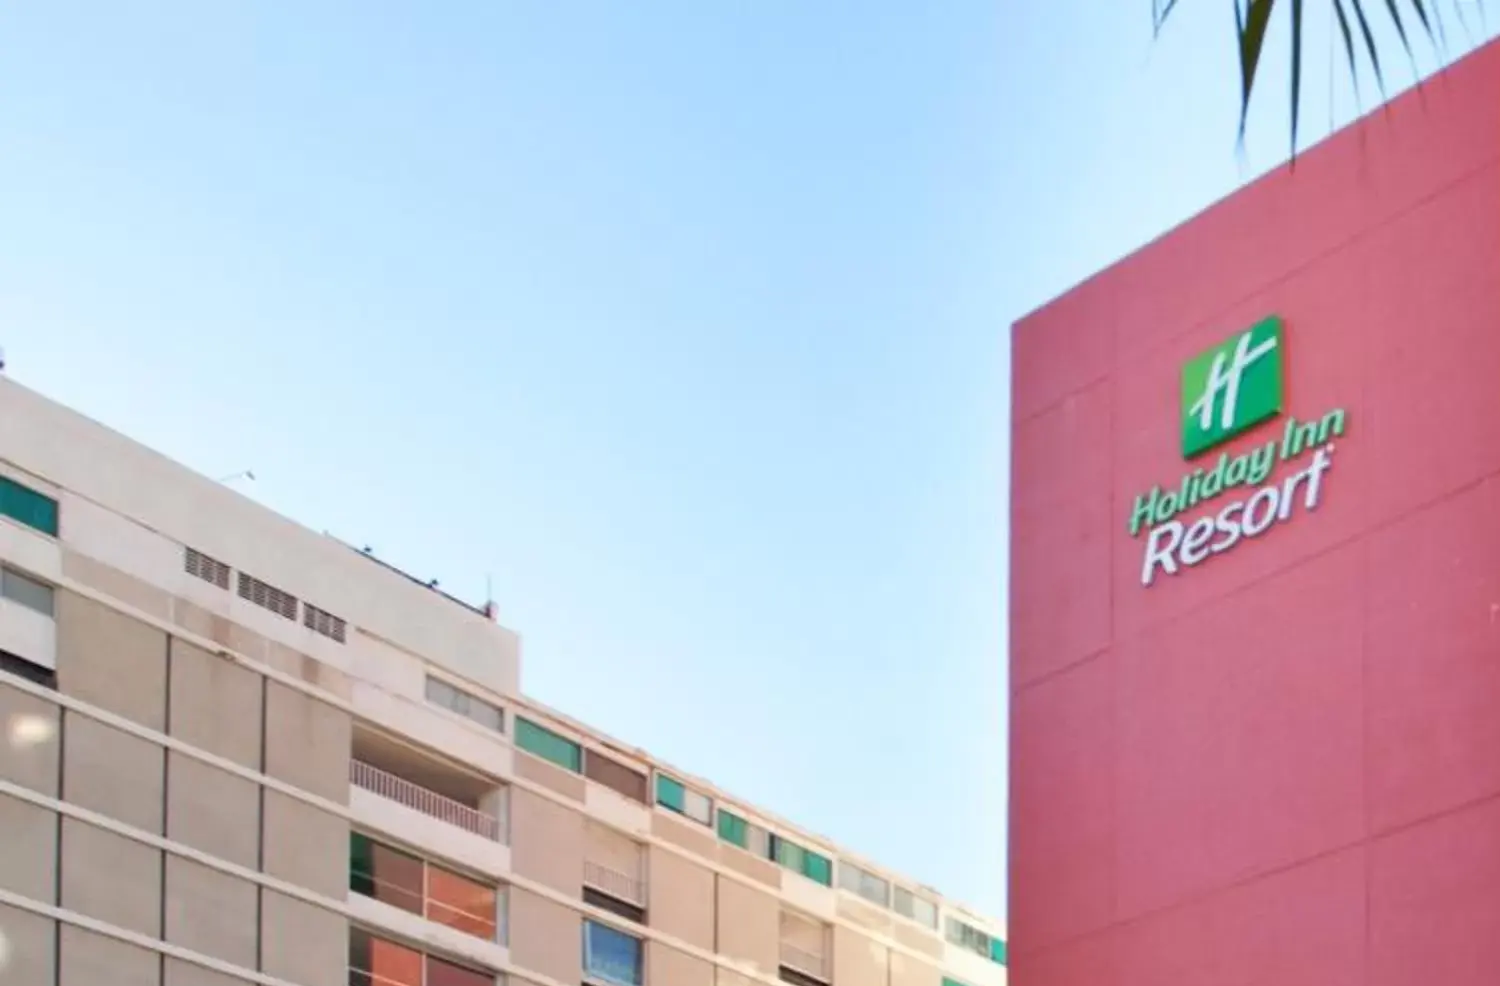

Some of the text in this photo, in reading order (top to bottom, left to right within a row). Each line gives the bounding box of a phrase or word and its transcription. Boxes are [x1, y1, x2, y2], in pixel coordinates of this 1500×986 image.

[1129, 407, 1346, 536] Holiday Inn
[1140, 442, 1336, 586] Resort
